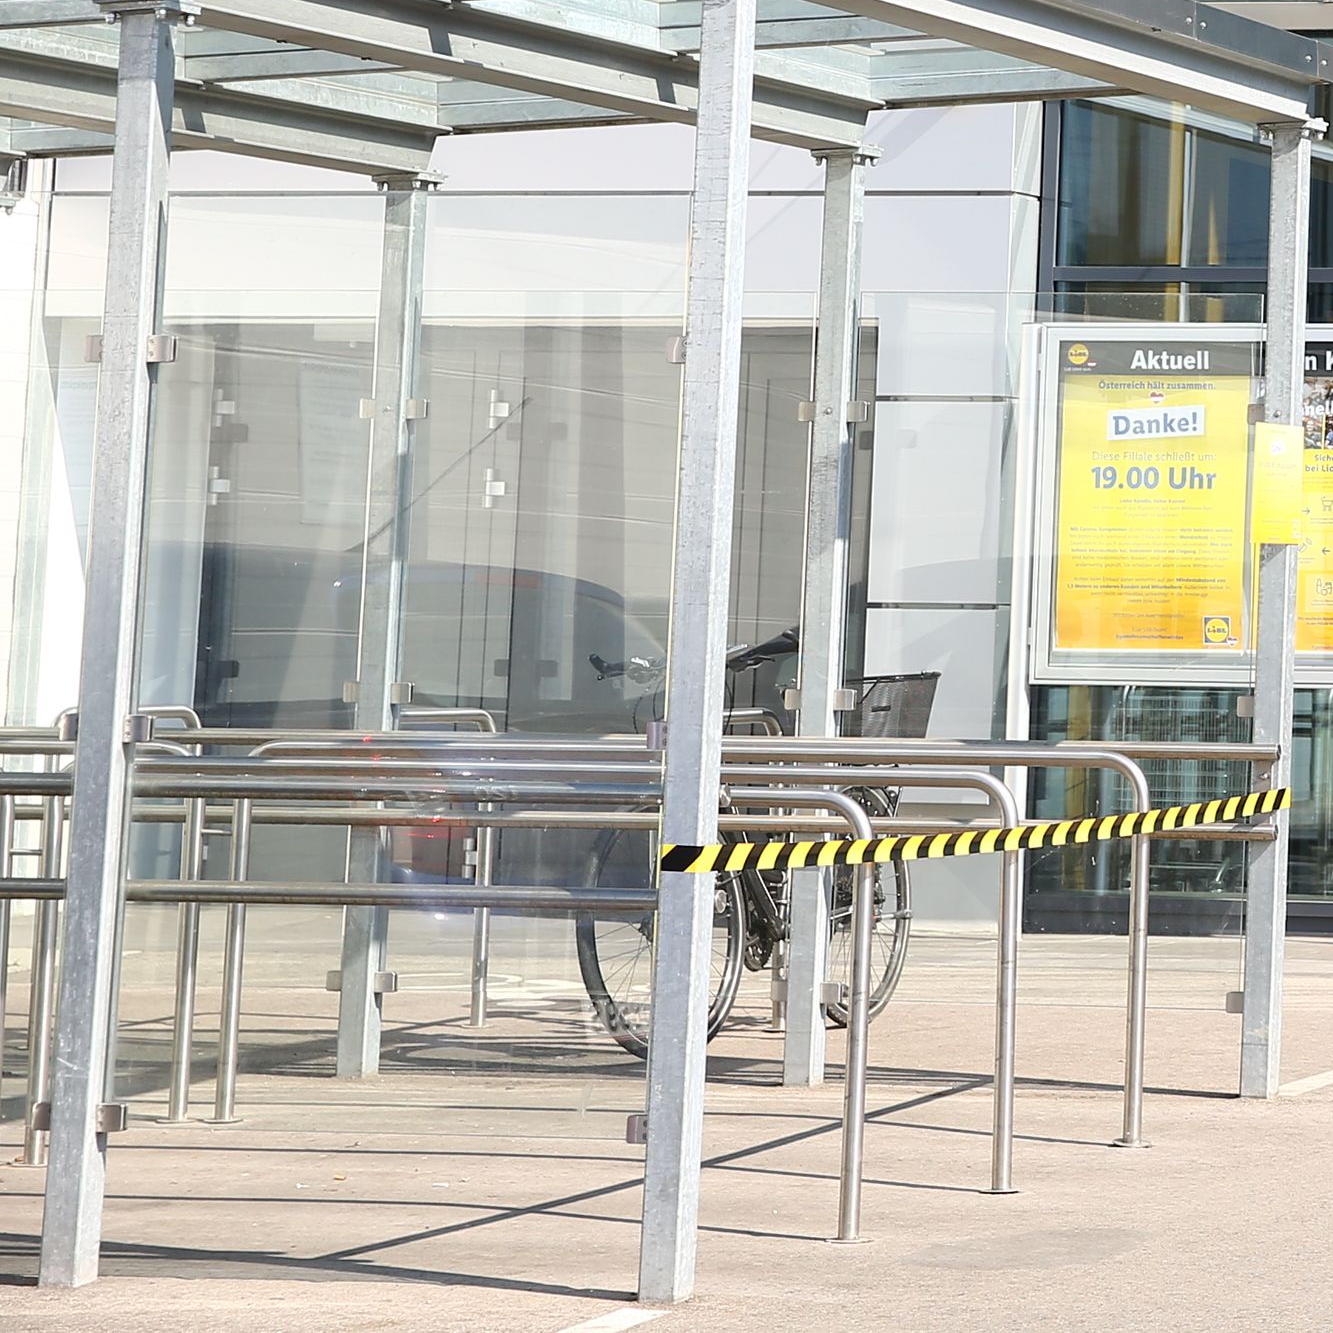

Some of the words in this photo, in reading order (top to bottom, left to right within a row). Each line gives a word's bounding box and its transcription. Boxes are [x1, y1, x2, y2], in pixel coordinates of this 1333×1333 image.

[1130, 349, 1210, 370] Aktuell
[1304, 355, 1317, 370] n
[1098, 379, 1145, 390] Österreich
[1147, 379, 1164, 390] hält
[1167, 381, 1216, 390] zusammen.
[1112, 411, 1198, 436] Danke!
[1092, 451, 1120, 462] Diese
[1123, 451, 1153, 462] Filiale
[1155, 451, 1194, 462] schließt
[1198, 453, 1217, 462] um:
[1305, 464, 1319, 473] bei
[1091, 466, 1159, 489] 19.00
[1169, 466, 1217, 490] Uhr
